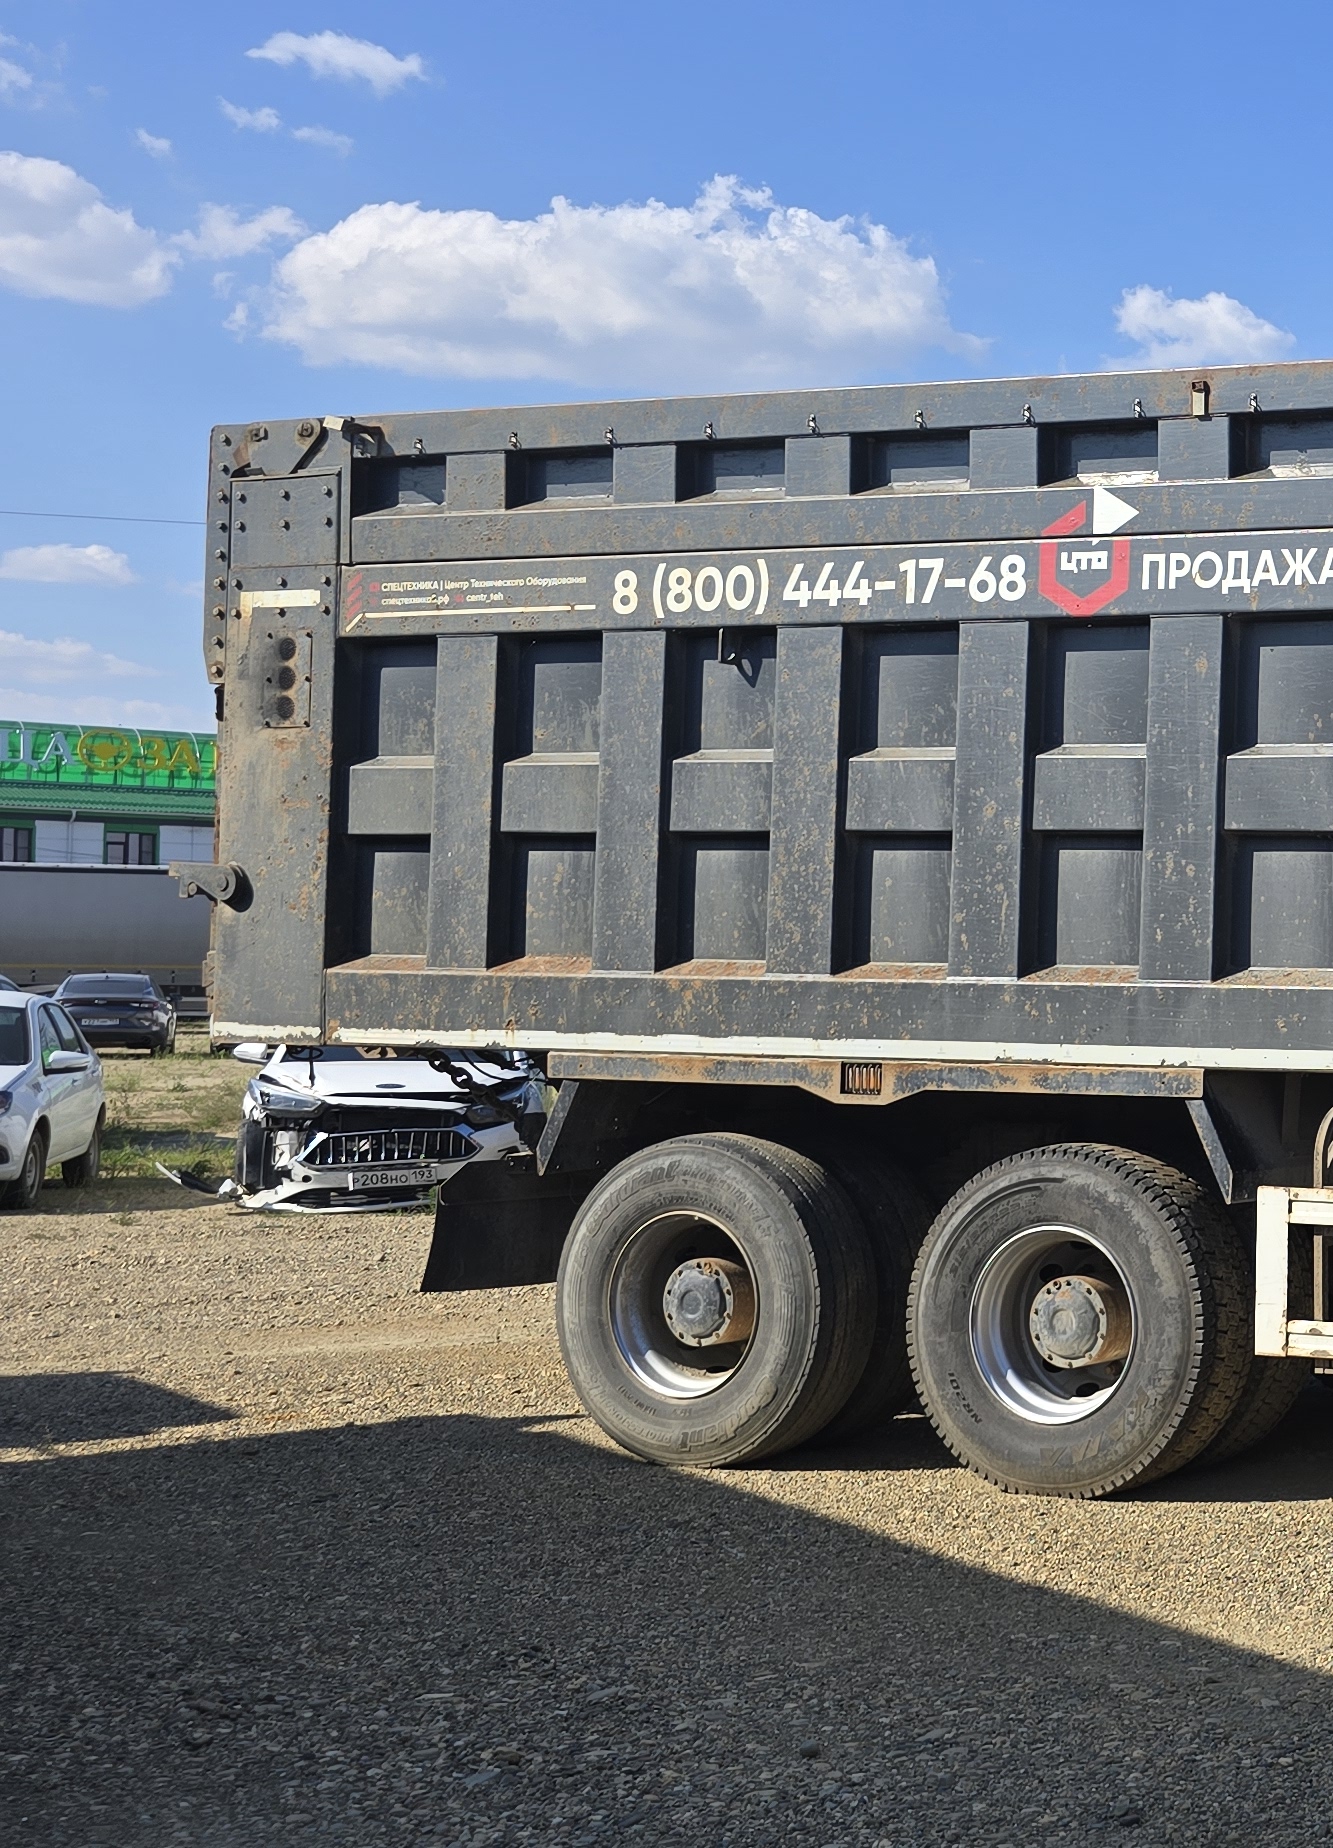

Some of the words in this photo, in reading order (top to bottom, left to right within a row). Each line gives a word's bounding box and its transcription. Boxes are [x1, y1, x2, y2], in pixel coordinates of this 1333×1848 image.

[381, 580, 439, 591] СПЕЦТЕХНИКА
[444, 580, 469, 591] Центр
[470, 577, 525, 588] Технического
[612, 570, 639, 615] 8
[653, 558, 770, 618] (800)
[783, 554, 1027, 608] 444-17-68
[411, 1170, 433, 1180] 193
[947, 1371, 983, 1425] NR201
